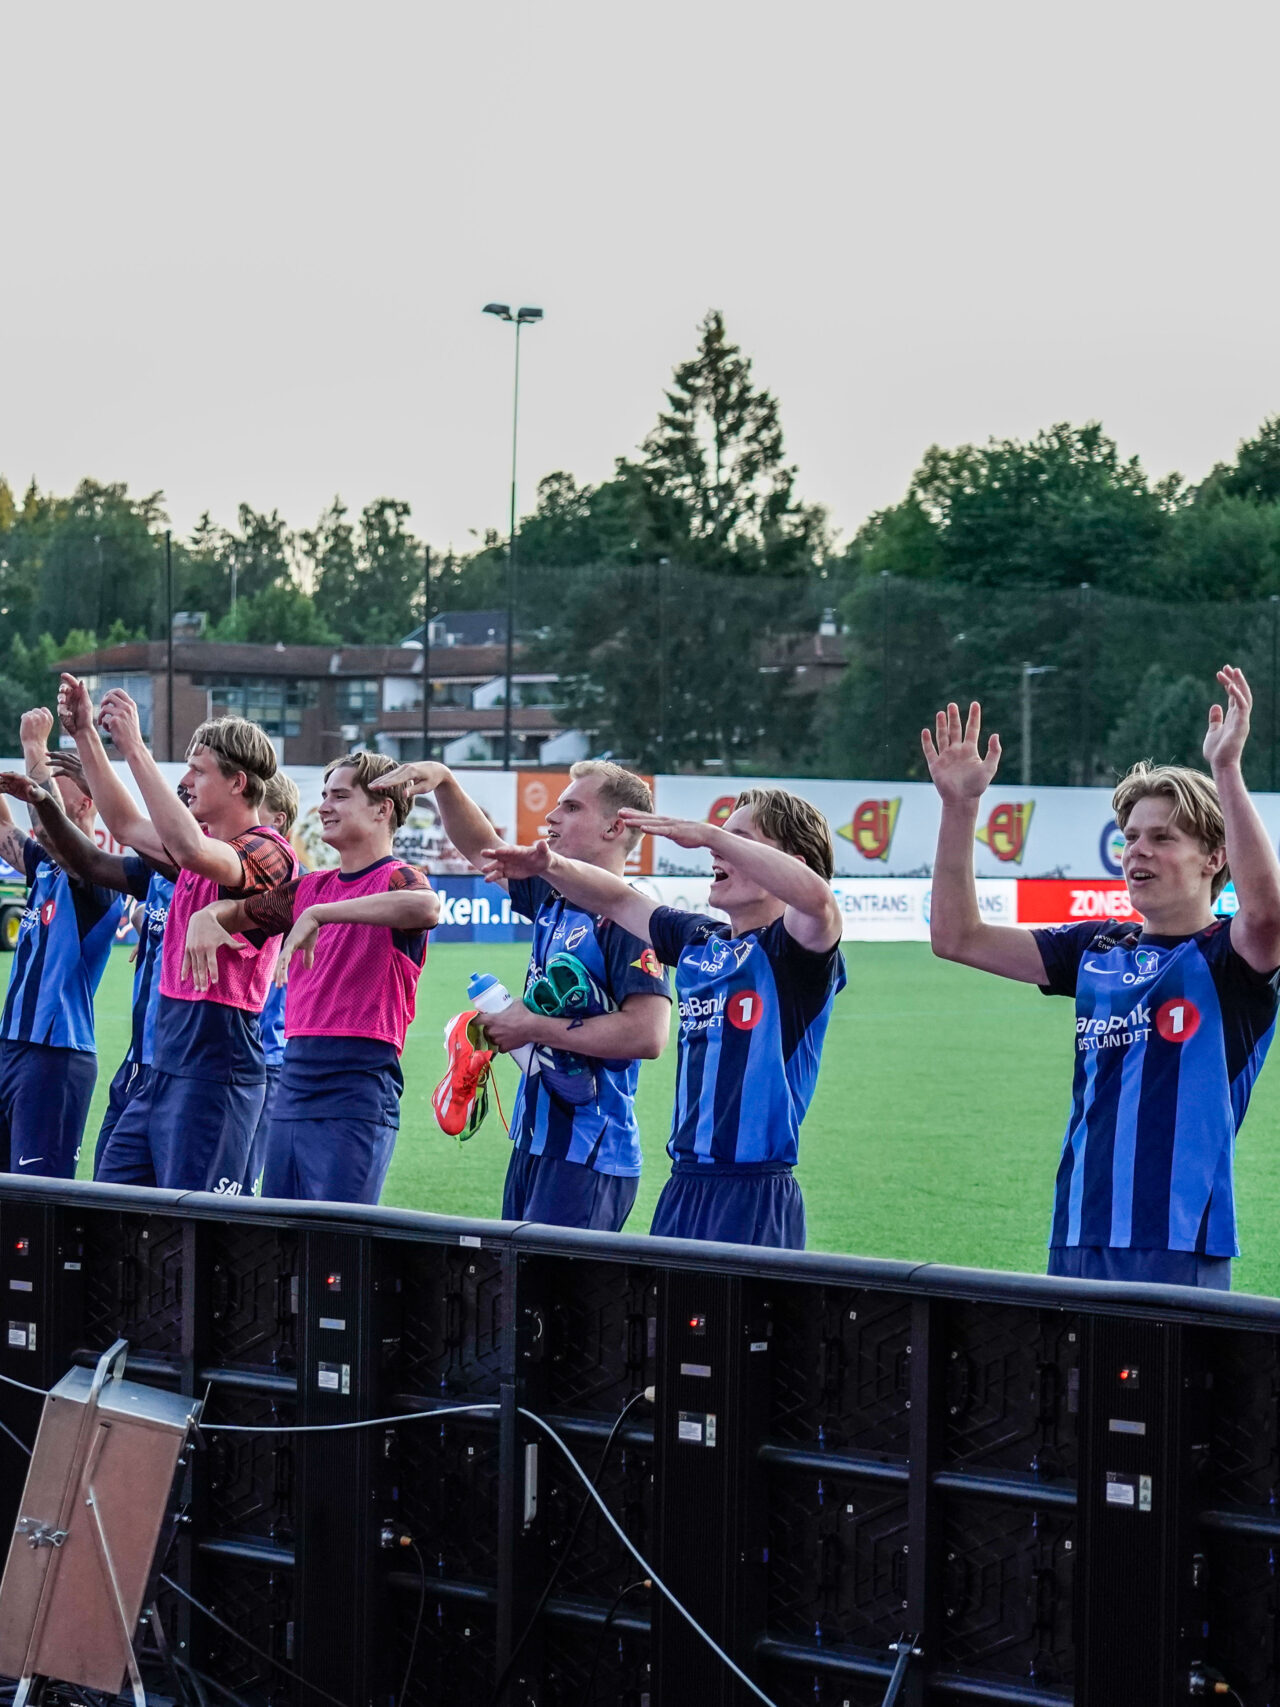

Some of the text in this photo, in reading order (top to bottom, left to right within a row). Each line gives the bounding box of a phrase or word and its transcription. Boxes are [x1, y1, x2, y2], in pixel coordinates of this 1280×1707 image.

[46, 904, 53, 921] 1
[439, 890, 533, 926] ken.n
[1070, 890, 1134, 917] ZONES
[739, 998, 753, 1022] 1
[1169, 1006, 1184, 1034] 1
